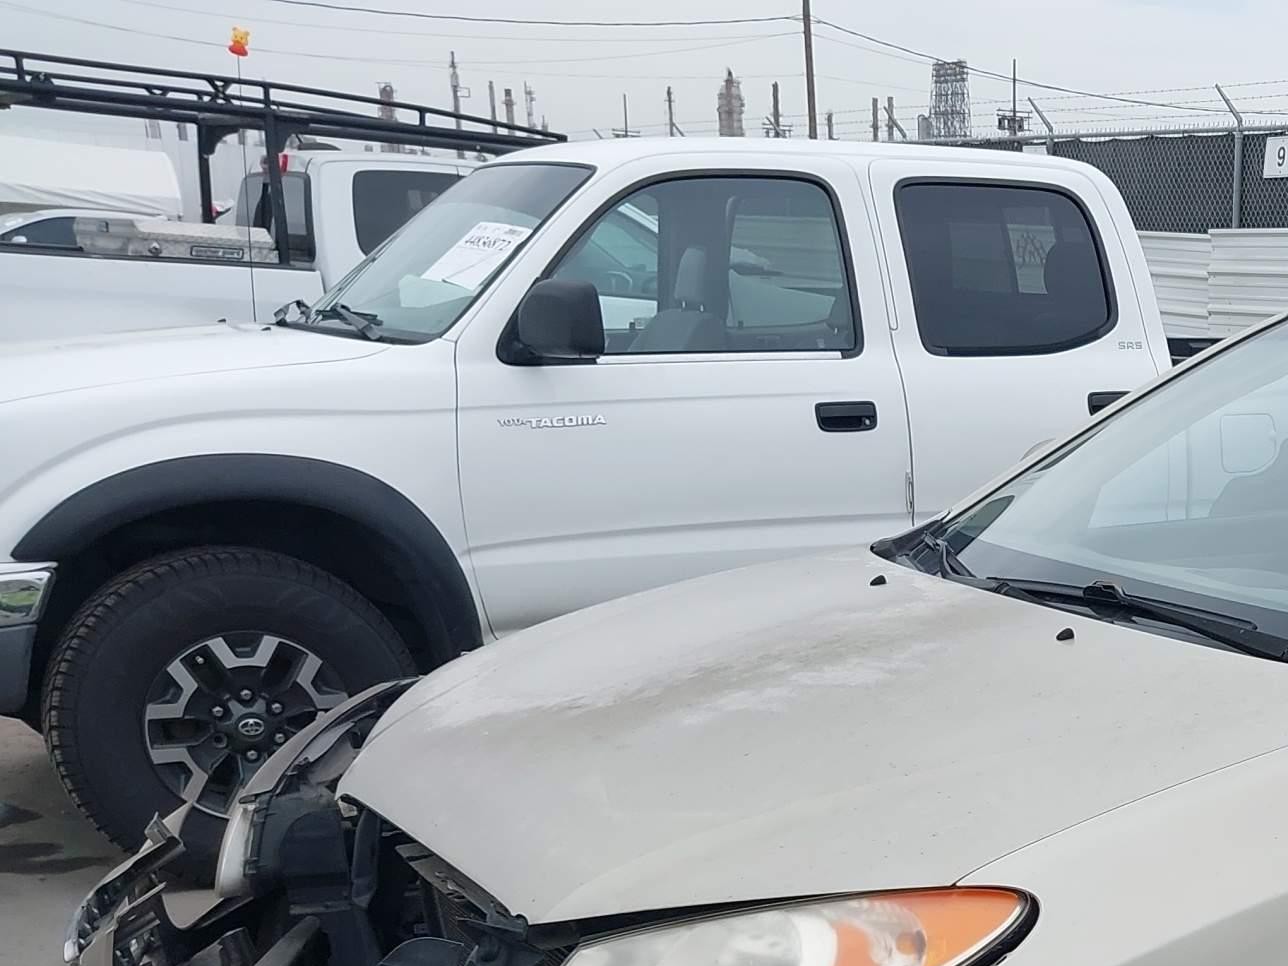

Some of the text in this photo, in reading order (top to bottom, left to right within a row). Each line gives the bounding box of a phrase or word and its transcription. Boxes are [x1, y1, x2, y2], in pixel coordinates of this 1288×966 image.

[1277, 146, 1286, 167] 9
[1118, 341, 1142, 350] SRS
[527, 414, 607, 429] TACOMA
